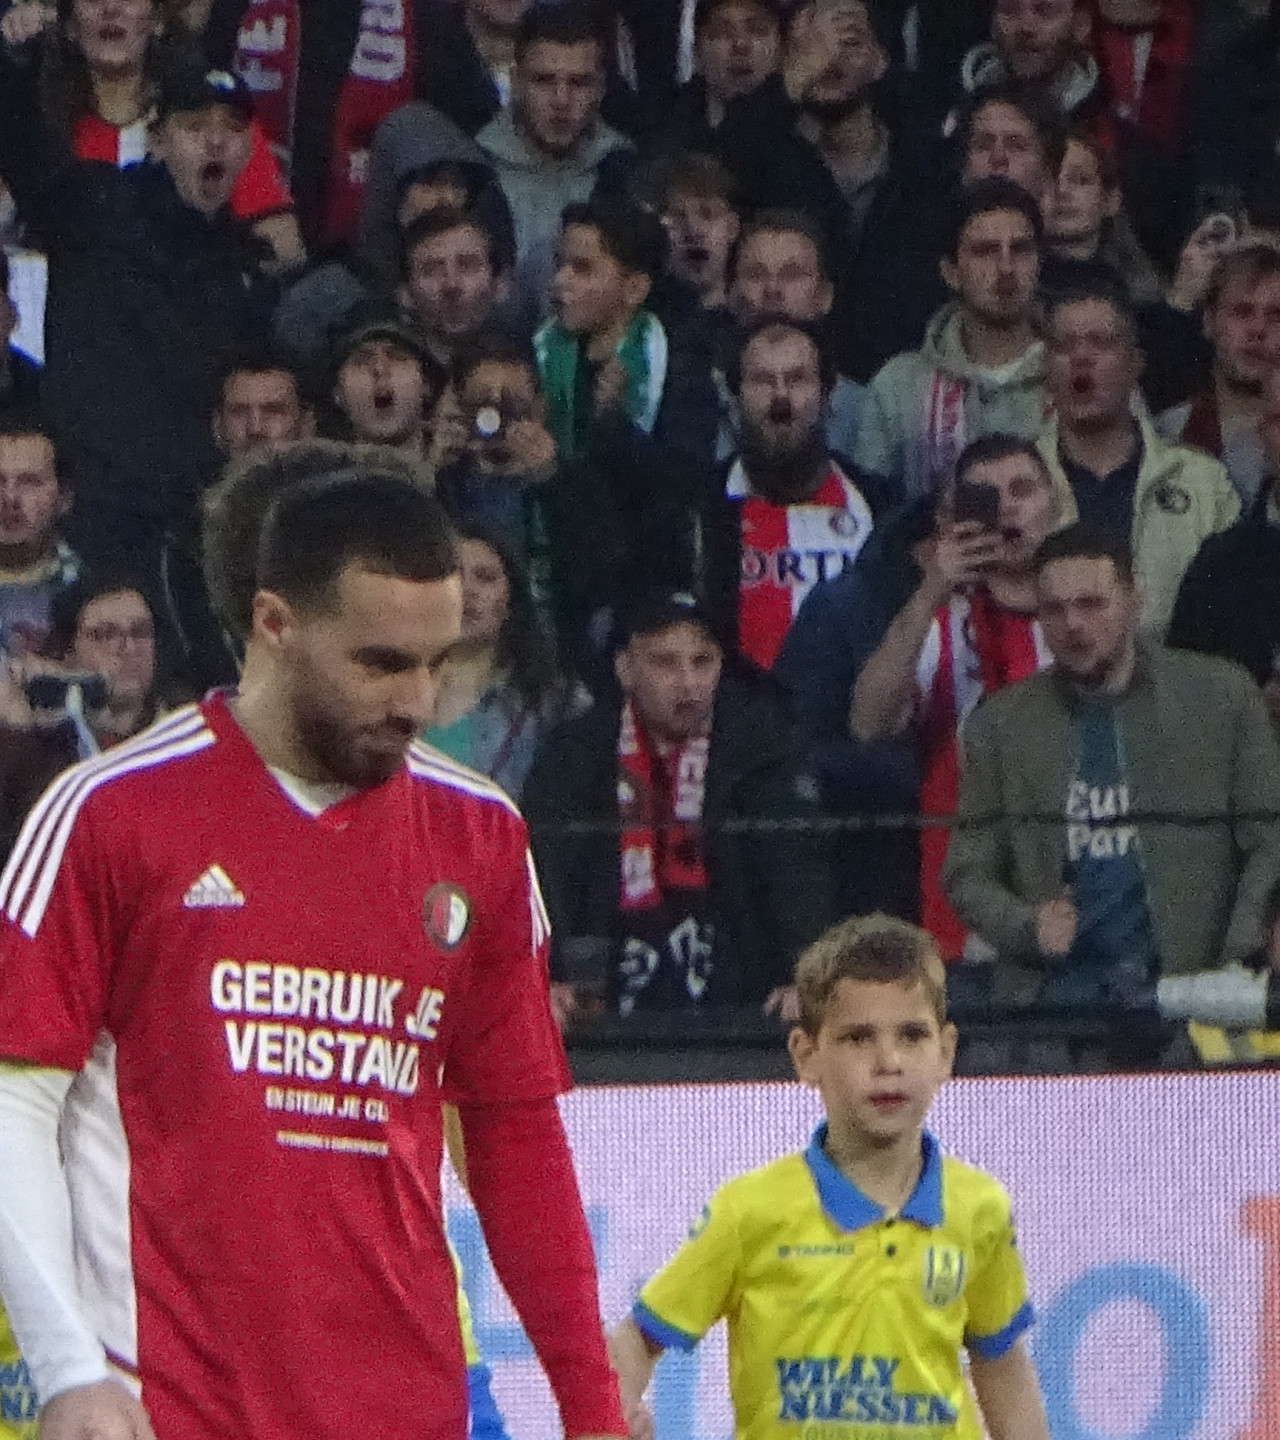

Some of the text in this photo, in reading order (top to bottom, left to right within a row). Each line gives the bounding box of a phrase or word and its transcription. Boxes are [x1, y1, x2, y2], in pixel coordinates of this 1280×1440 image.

[210, 960, 445, 1042] GEBRUIK JE
[224, 1019, 420, 1096] VERSTAND
